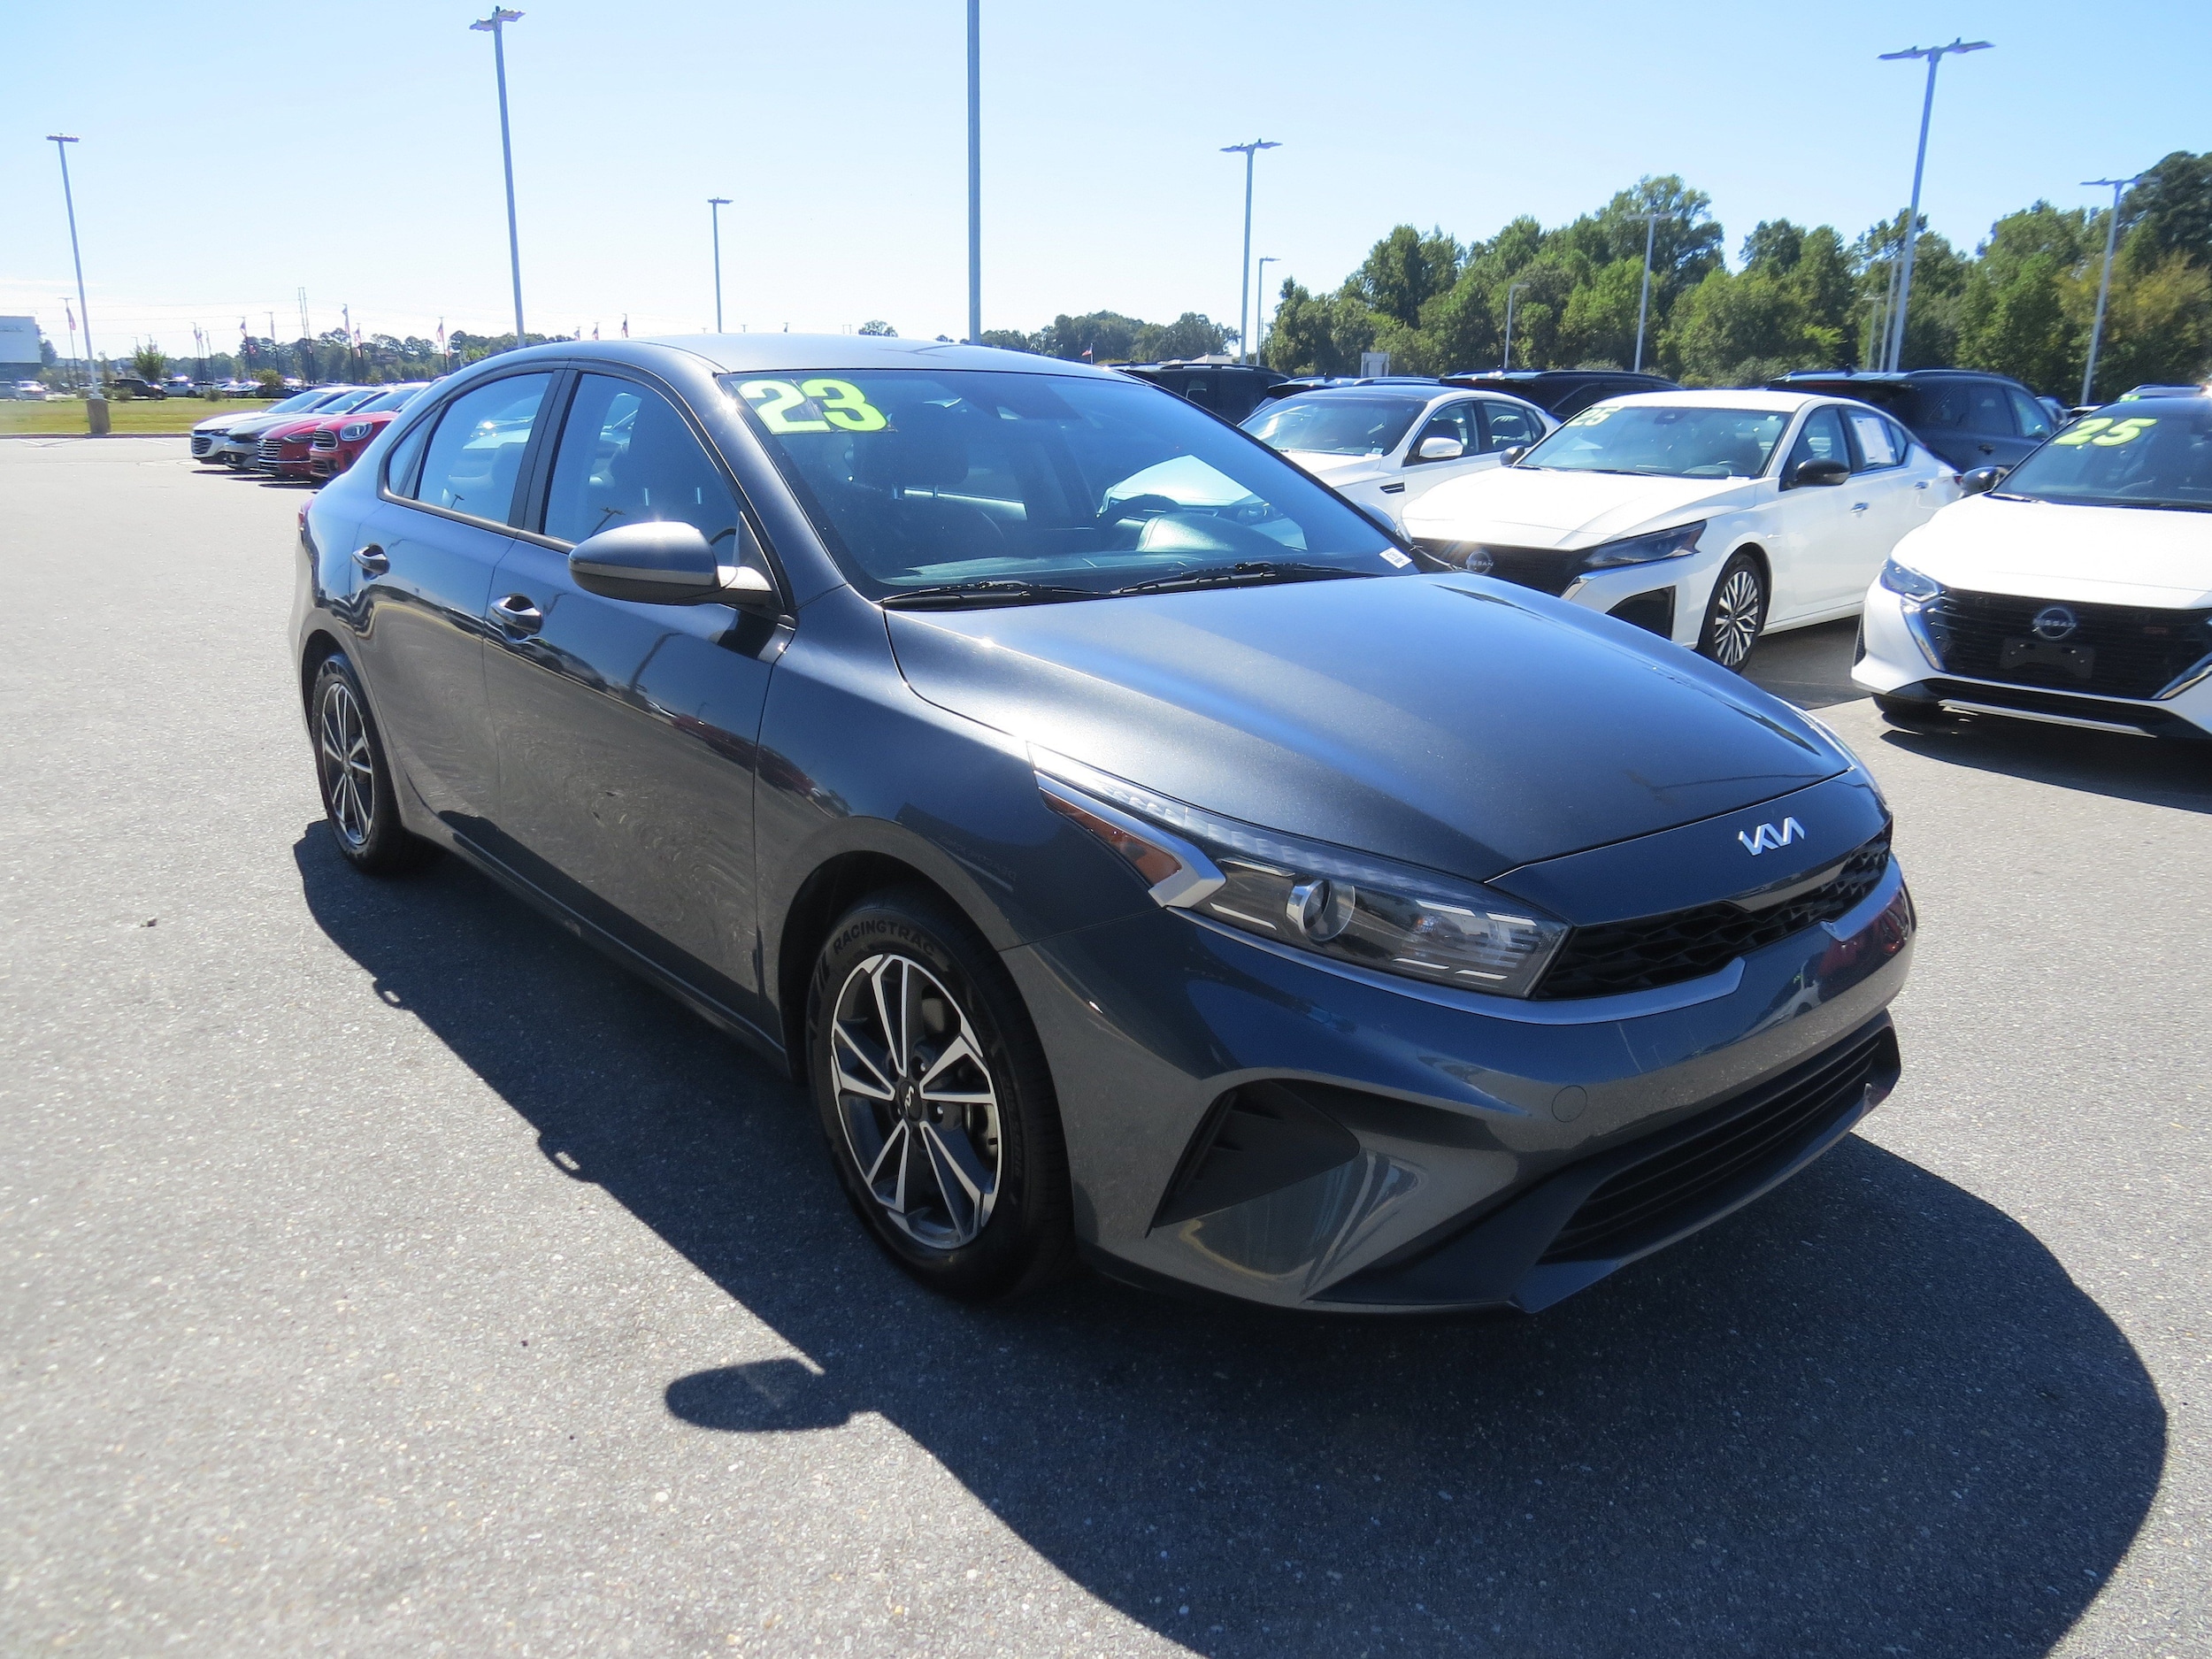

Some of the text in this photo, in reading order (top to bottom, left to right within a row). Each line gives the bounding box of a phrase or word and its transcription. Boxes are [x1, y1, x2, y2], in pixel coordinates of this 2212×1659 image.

[737, 378, 887, 434] 23
[1564, 407, 1622, 426] 25
[2053, 418, 2158, 447] 25
[1738, 816, 1805, 856] KIA
[833, 919, 935, 956] RACINGTRAC
